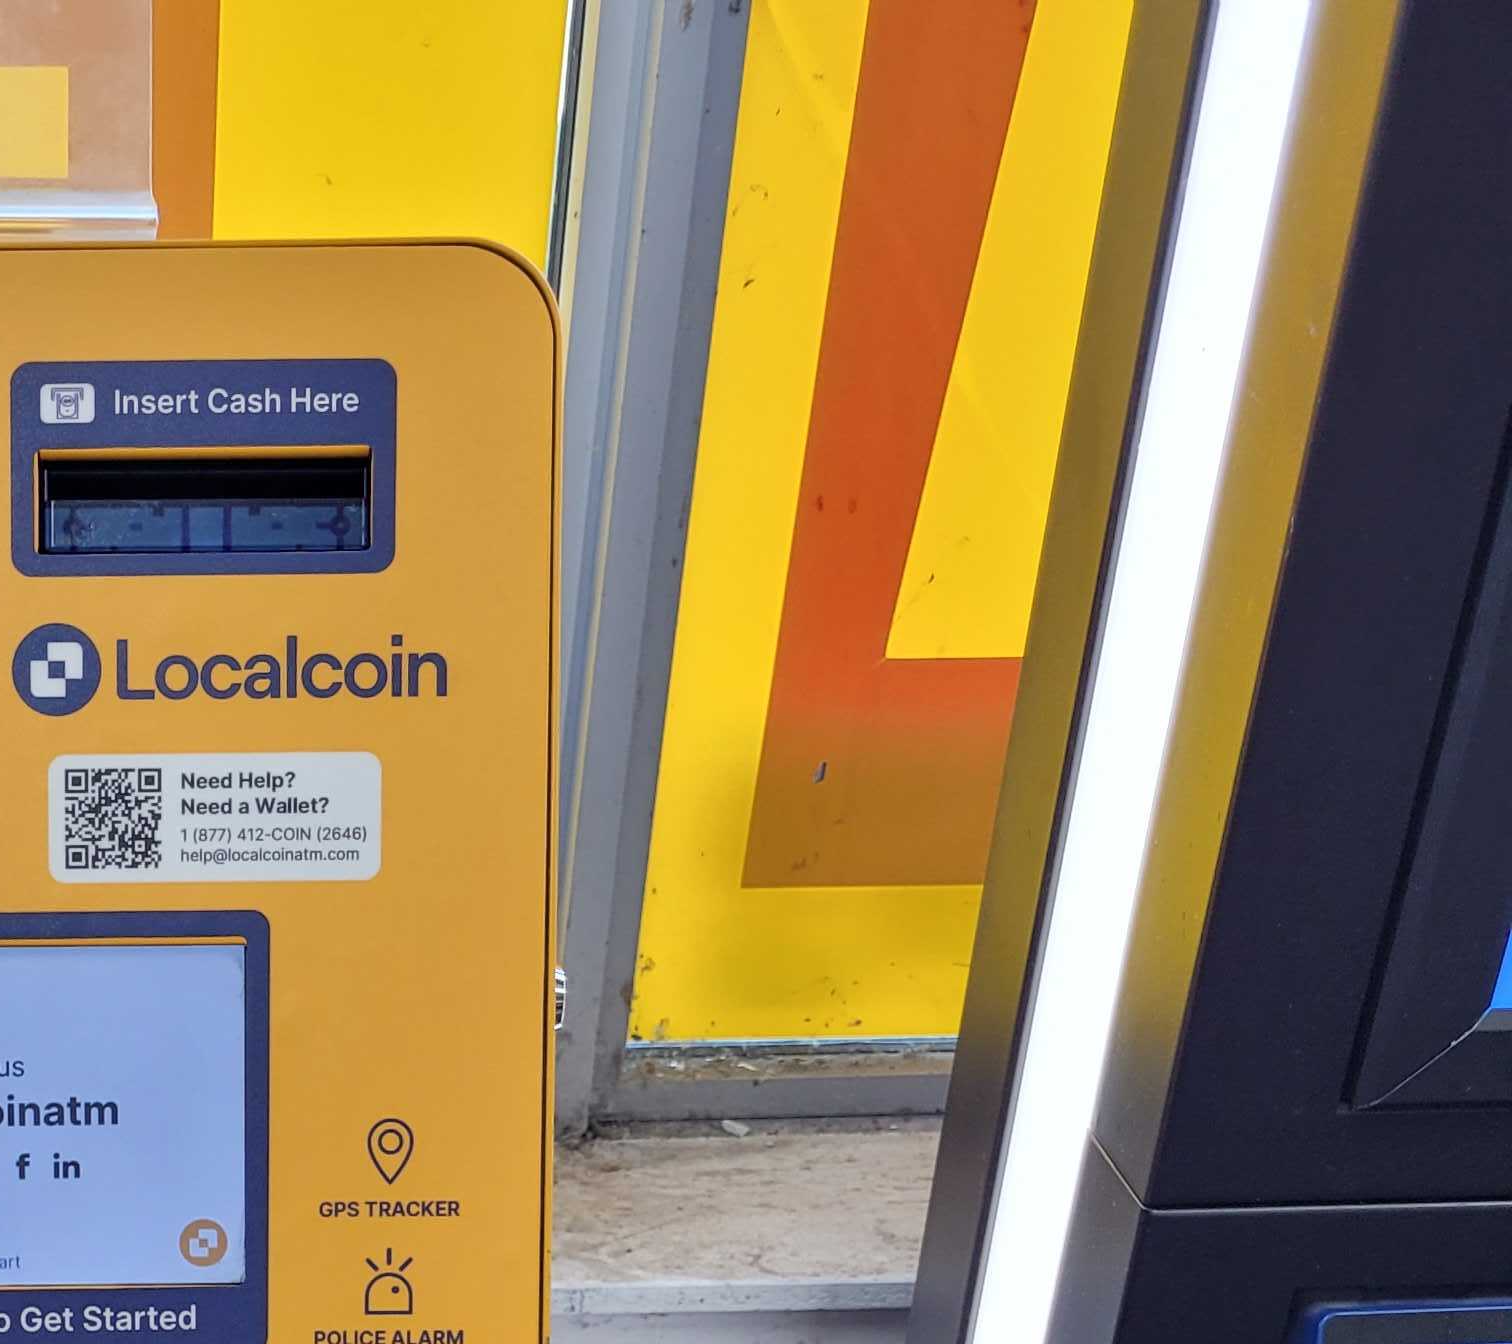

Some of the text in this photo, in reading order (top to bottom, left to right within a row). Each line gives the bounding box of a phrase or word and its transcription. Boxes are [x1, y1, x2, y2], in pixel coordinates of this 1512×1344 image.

[114, 387, 360, 415] Insert Cash Here
[116, 633, 449, 700] Localcoin
[180, 771, 296, 793] Need Help?
[180, 796, 330, 815] Need a Wallet?
[180, 825, 368, 845] 1 (877) 412-COIN (2646)
[180, 848, 360, 865] help@localcoinatm.com
[319, 1200, 461, 1218] GPS TRACKER
[19, 1306, 74, 1334] Get
[82, 1304, 198, 1333] Started
